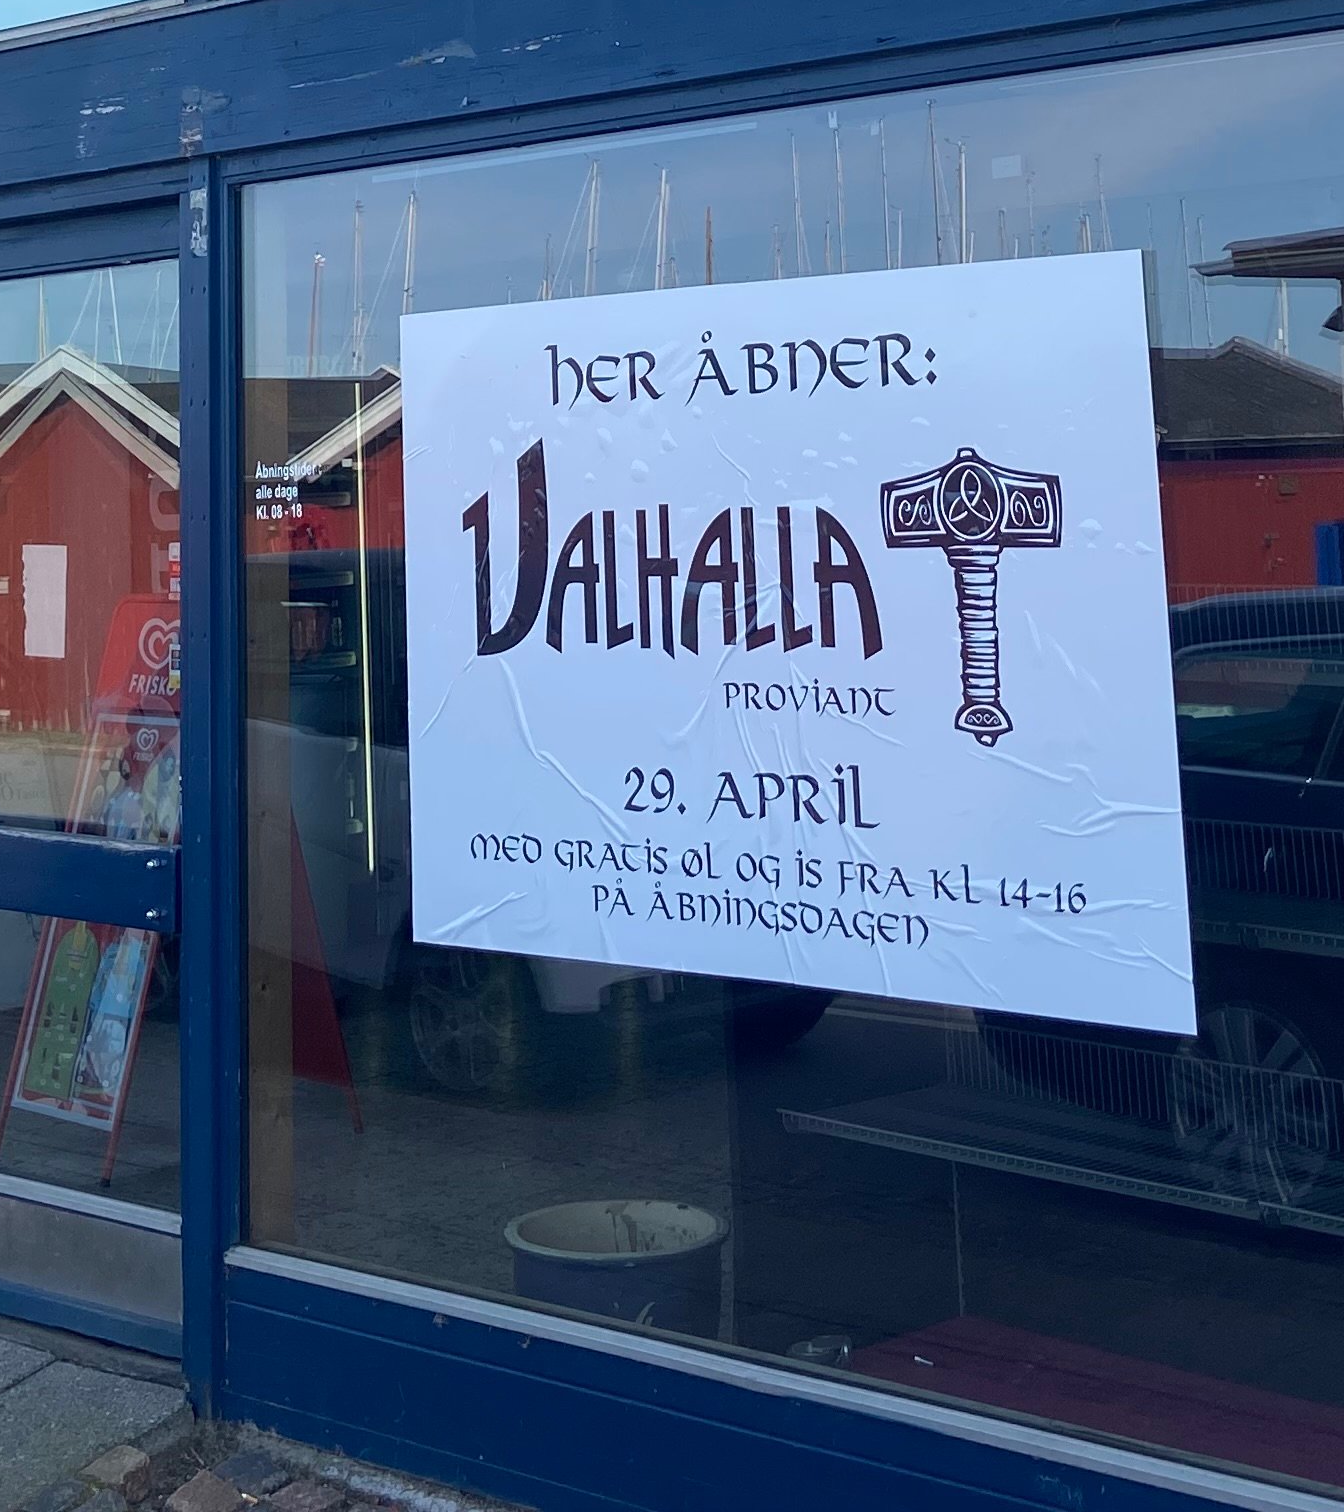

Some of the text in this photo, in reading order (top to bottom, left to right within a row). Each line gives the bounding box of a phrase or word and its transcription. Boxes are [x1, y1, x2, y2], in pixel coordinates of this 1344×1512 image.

[545, 331, 938, 411] HER ÅBNER:
[256, 483, 298, 501] alle dage
[271, 504, 283, 520] 08
[291, 502, 303, 519] 18
[462, 437, 884, 660] VALHALLA
[723, 678, 896, 717] PROVIANT
[623, 763, 881, 829] 29. APRIL
[470, 832, 1087, 914] MED GRATIS ØL OG IS FRA KL 14-16
[591, 878, 930, 950] PÅ ÅBNINGSDAGEN
